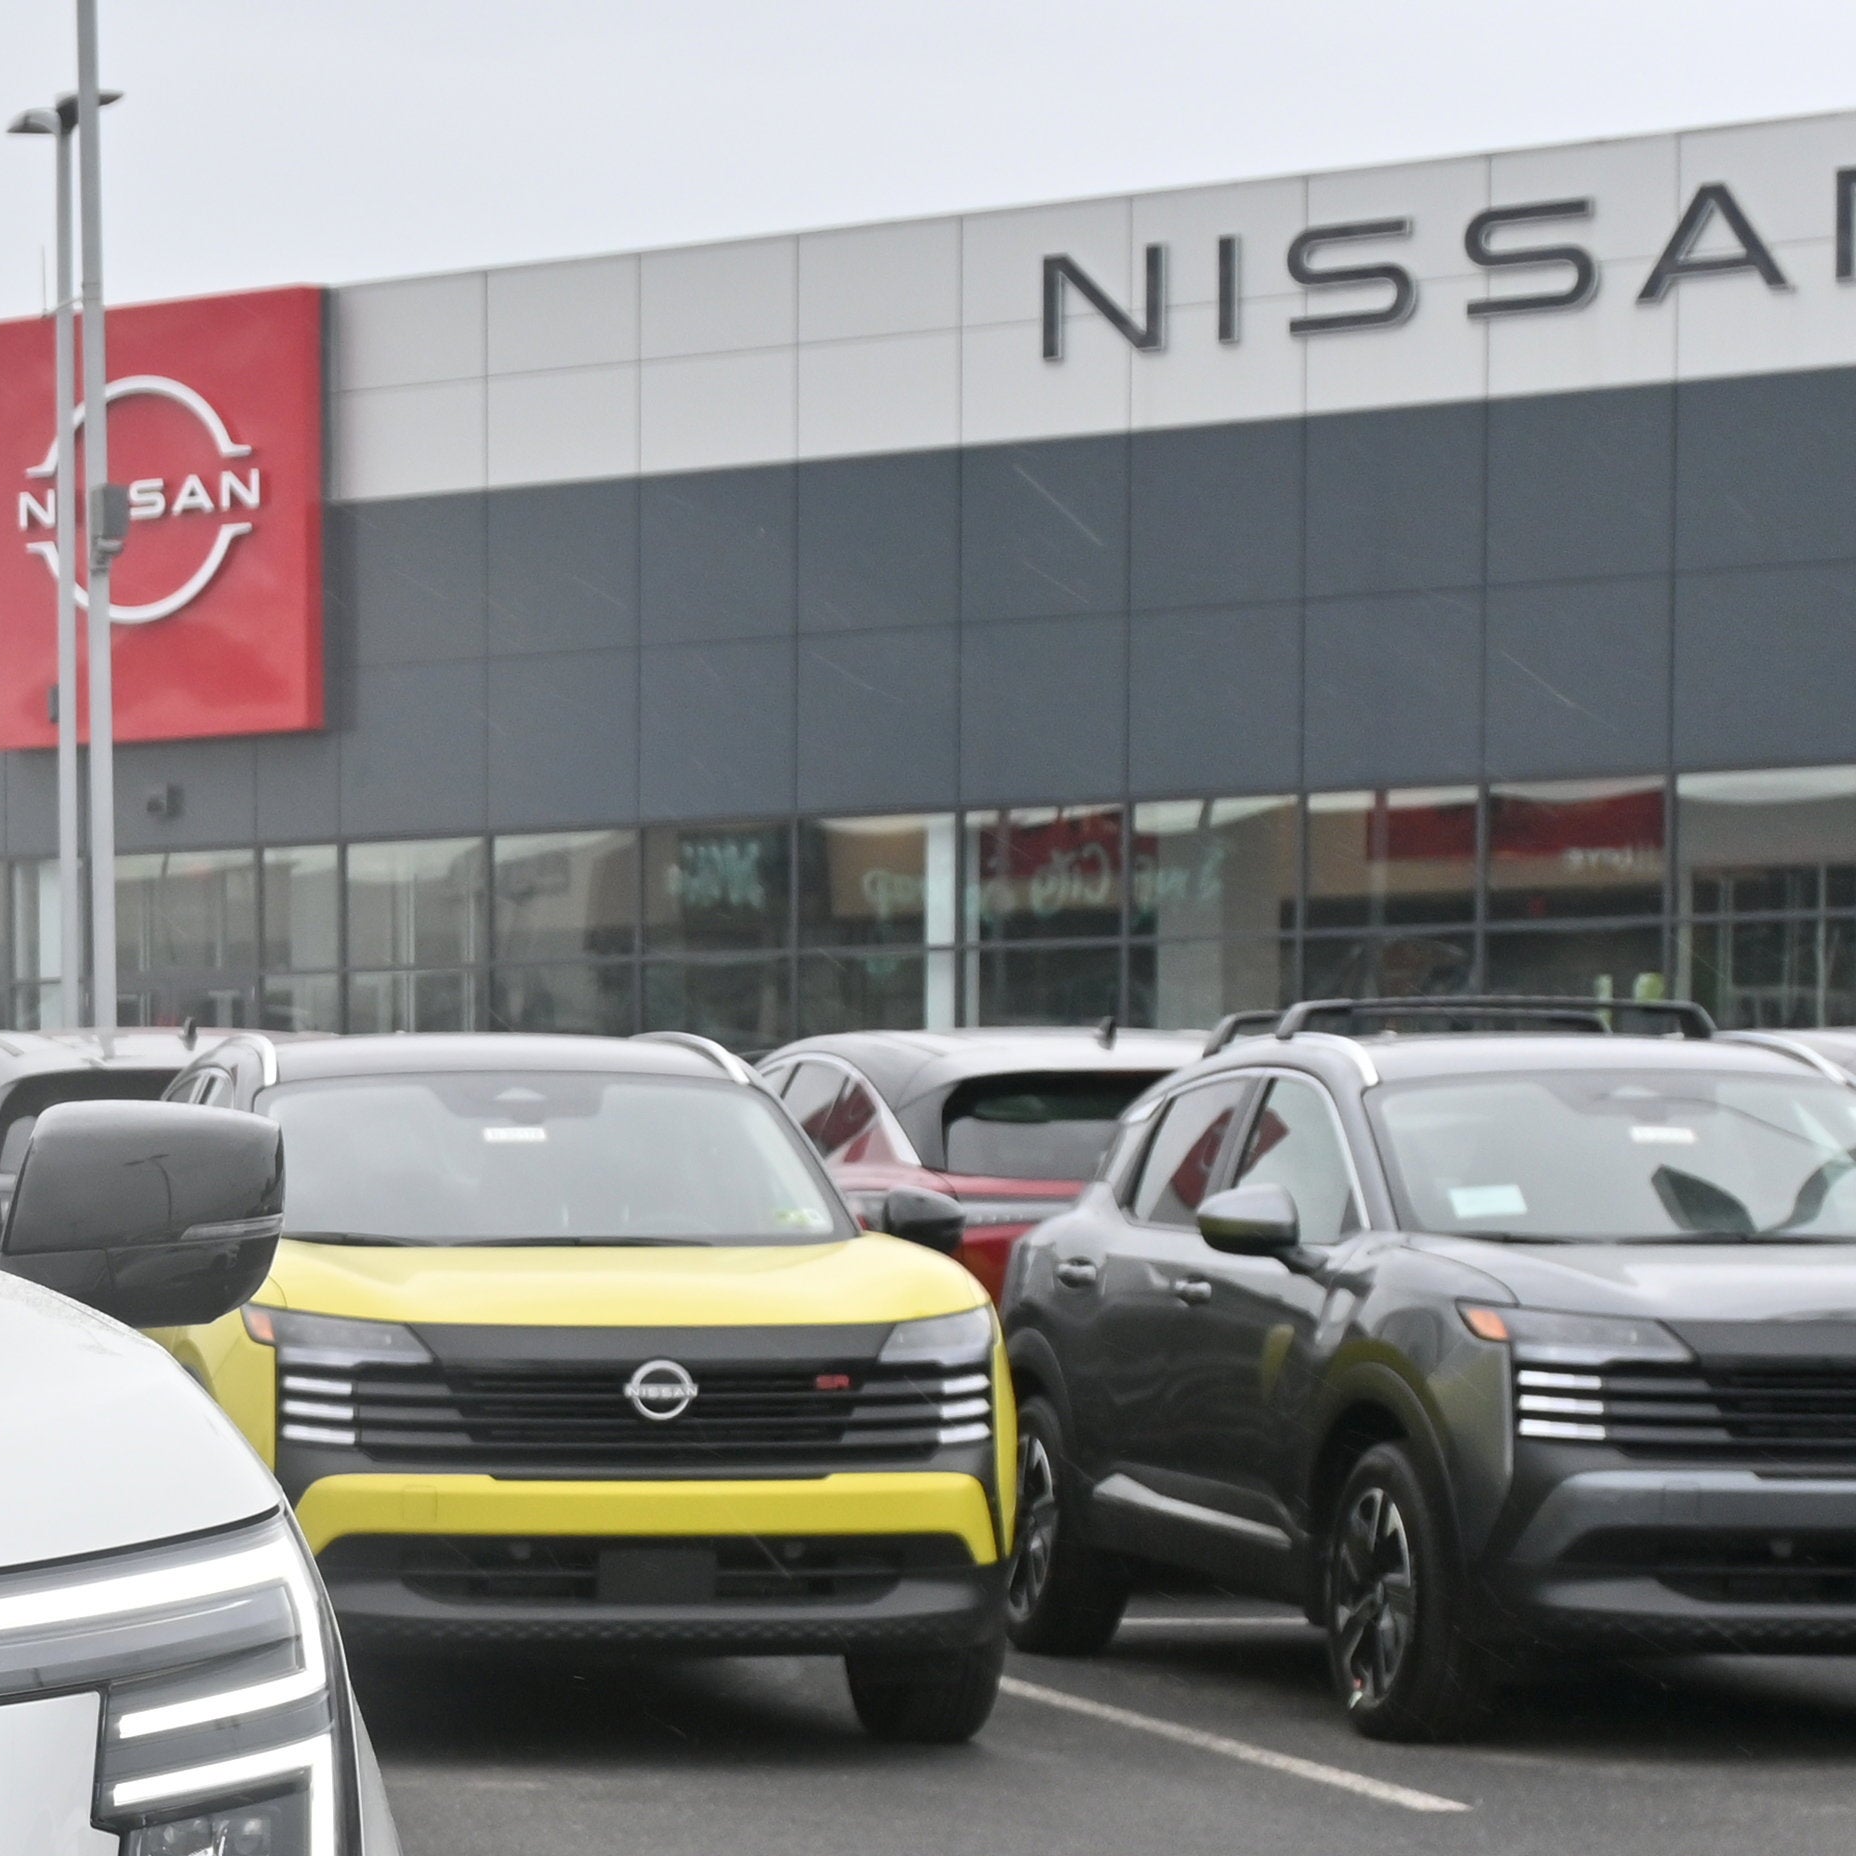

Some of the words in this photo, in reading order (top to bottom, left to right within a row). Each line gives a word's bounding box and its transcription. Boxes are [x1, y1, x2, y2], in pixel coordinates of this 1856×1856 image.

[1041, 166, 1856, 361] NISSA
[18, 467, 261, 530] NSAN
[625, 1385, 698, 1399] NISSAN
